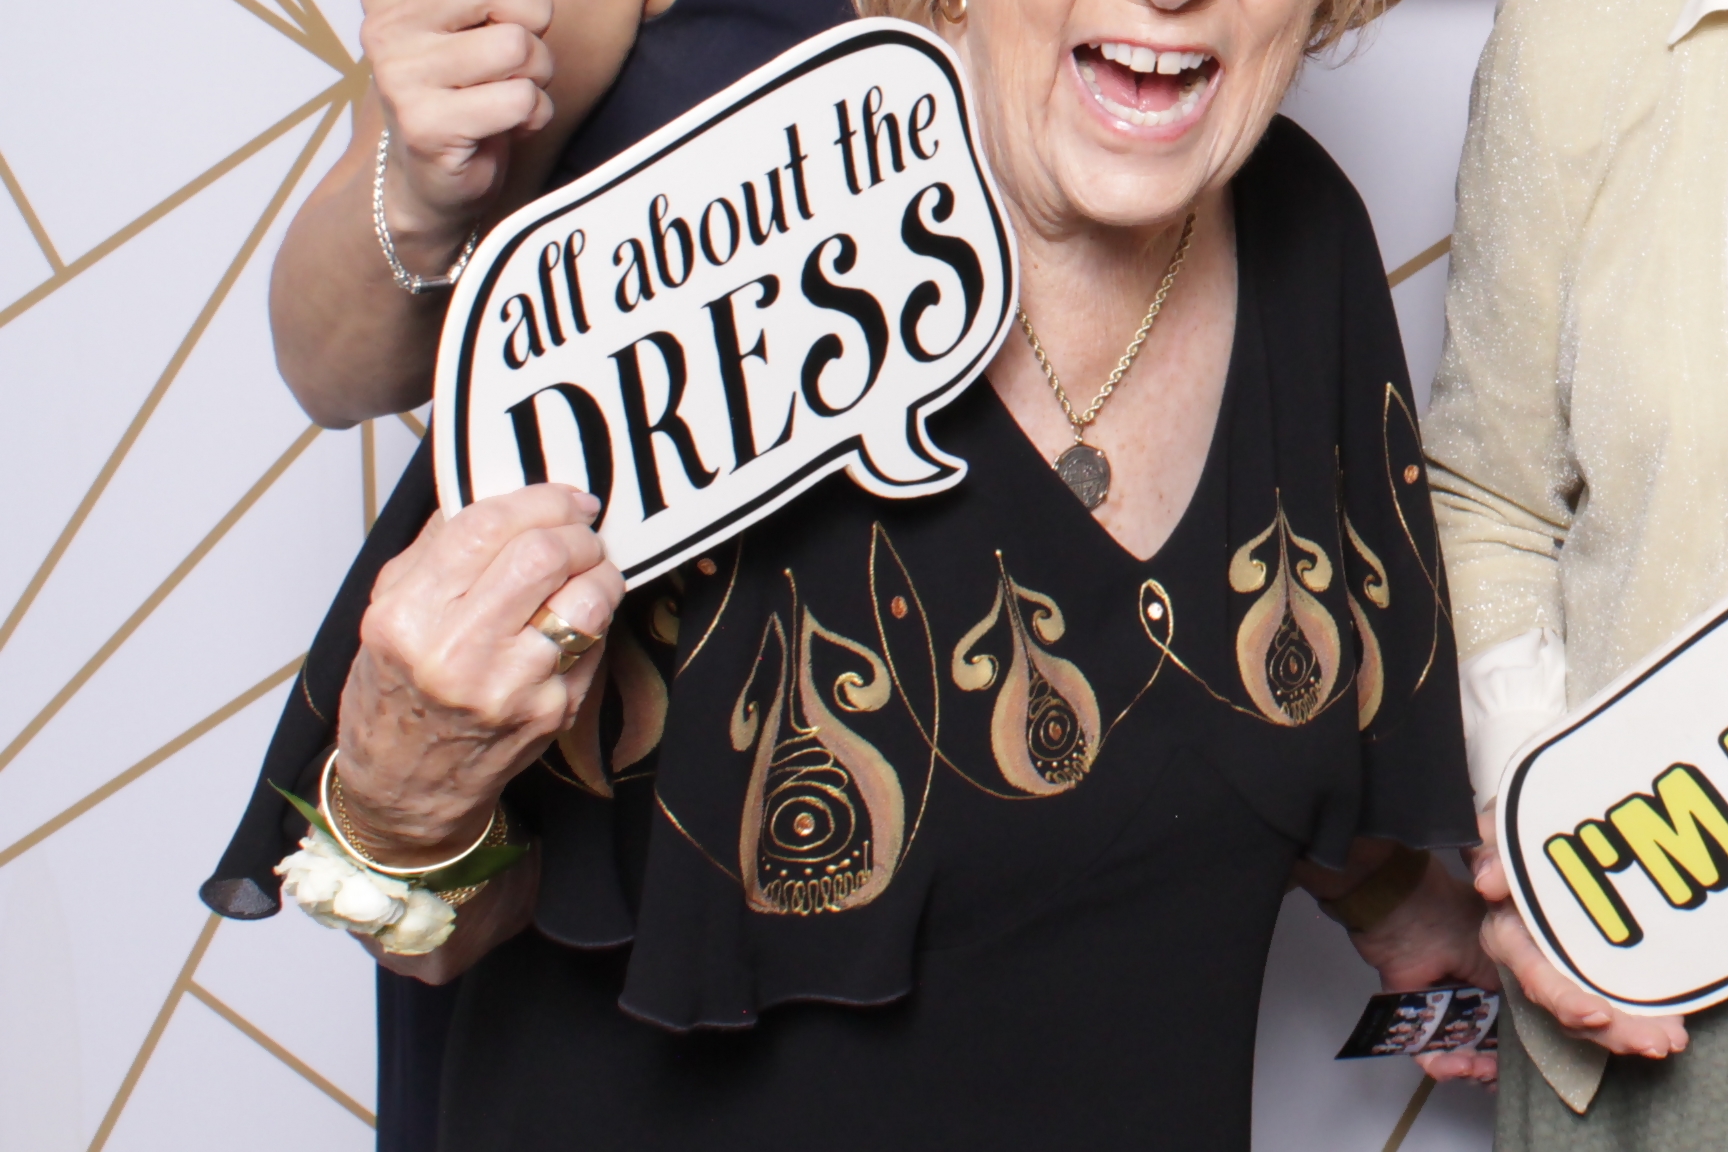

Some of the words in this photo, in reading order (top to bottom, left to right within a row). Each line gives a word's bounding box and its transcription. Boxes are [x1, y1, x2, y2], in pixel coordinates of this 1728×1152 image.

[500, 229, 591, 370] all
[612, 123, 815, 313] about
[834, 86, 939, 196] the
[504, 182, 984, 533] DRESS
